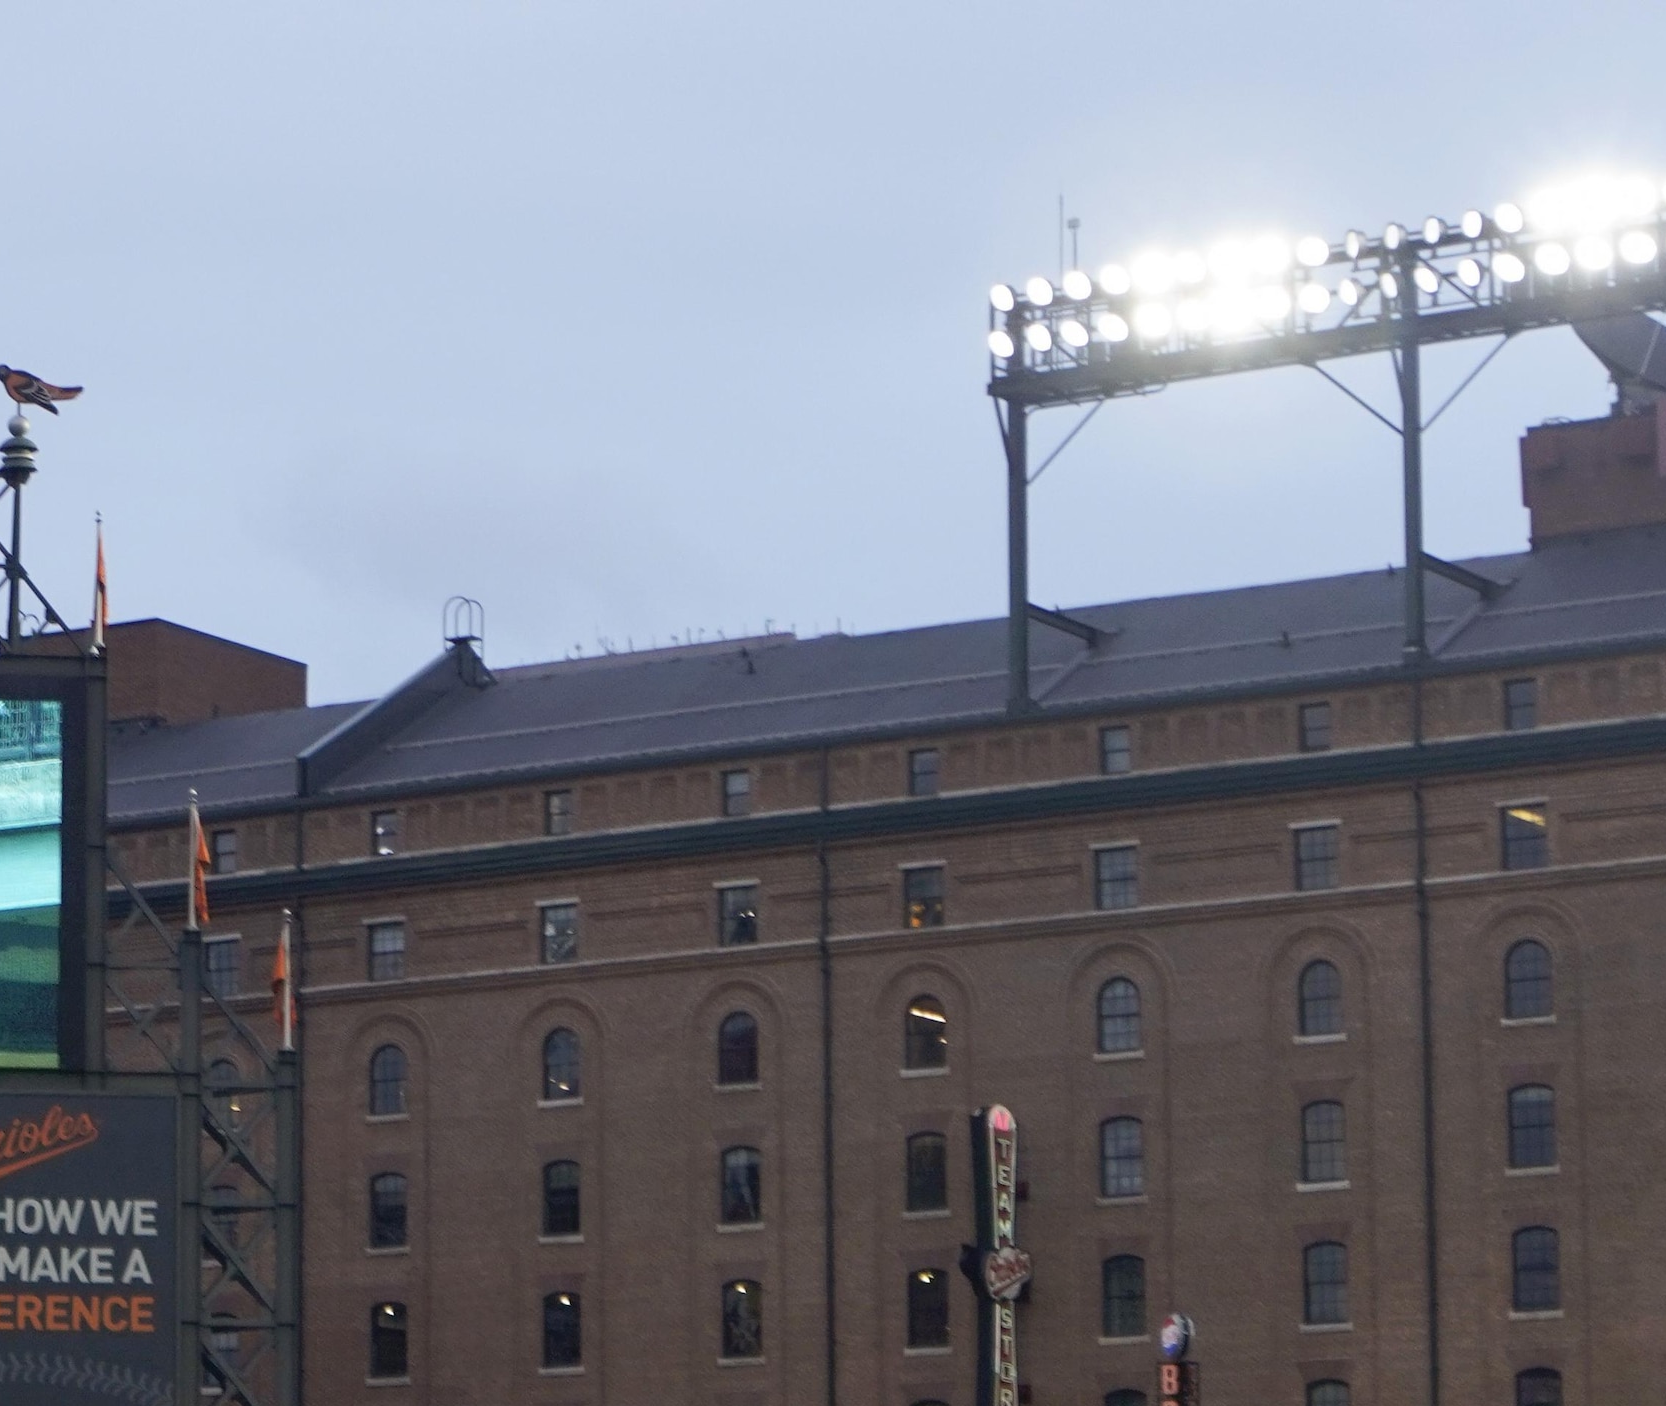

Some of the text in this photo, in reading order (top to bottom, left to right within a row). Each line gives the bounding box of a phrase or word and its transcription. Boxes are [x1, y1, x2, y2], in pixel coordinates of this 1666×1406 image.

[995, 1136, 1014, 1238] TEAM
[91, 1200, 159, 1236] WE
[122, 1248, 154, 1285] A
